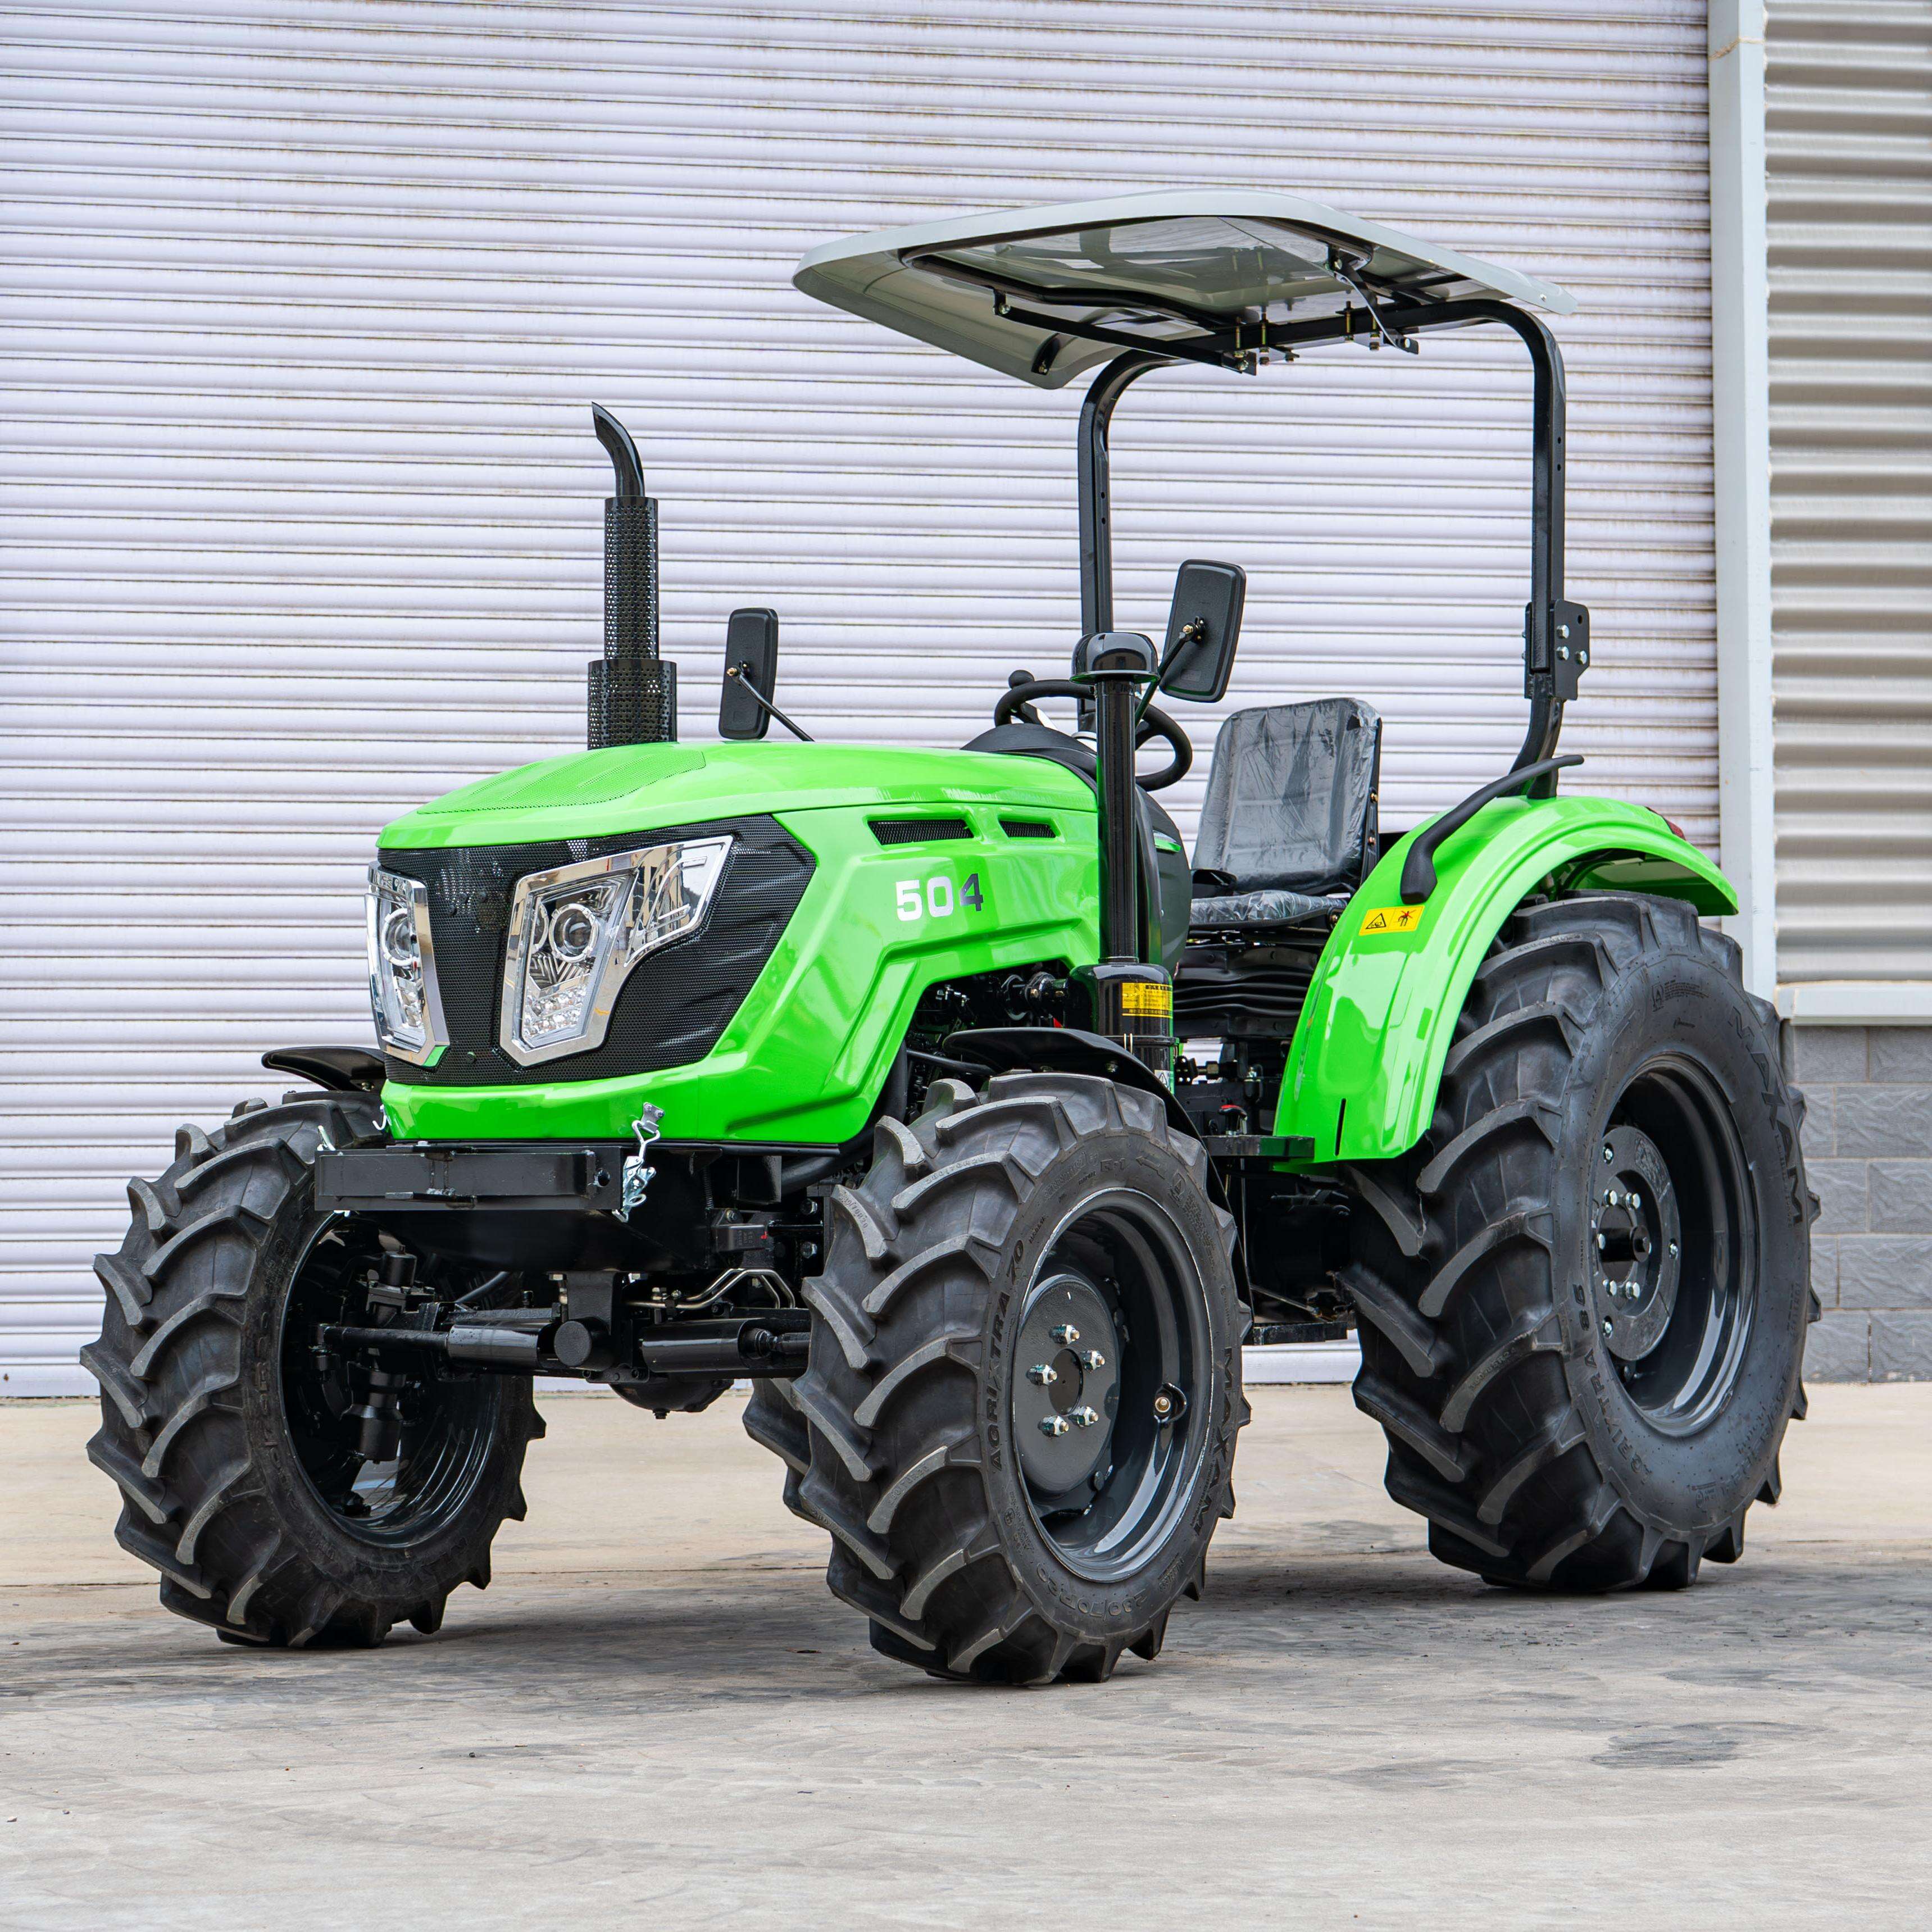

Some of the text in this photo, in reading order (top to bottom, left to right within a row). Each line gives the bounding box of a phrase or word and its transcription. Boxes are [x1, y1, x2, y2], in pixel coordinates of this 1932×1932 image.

[895, 873, 984, 921] 504
[985, 1239, 1024, 1471] AGRIXTRA 70
